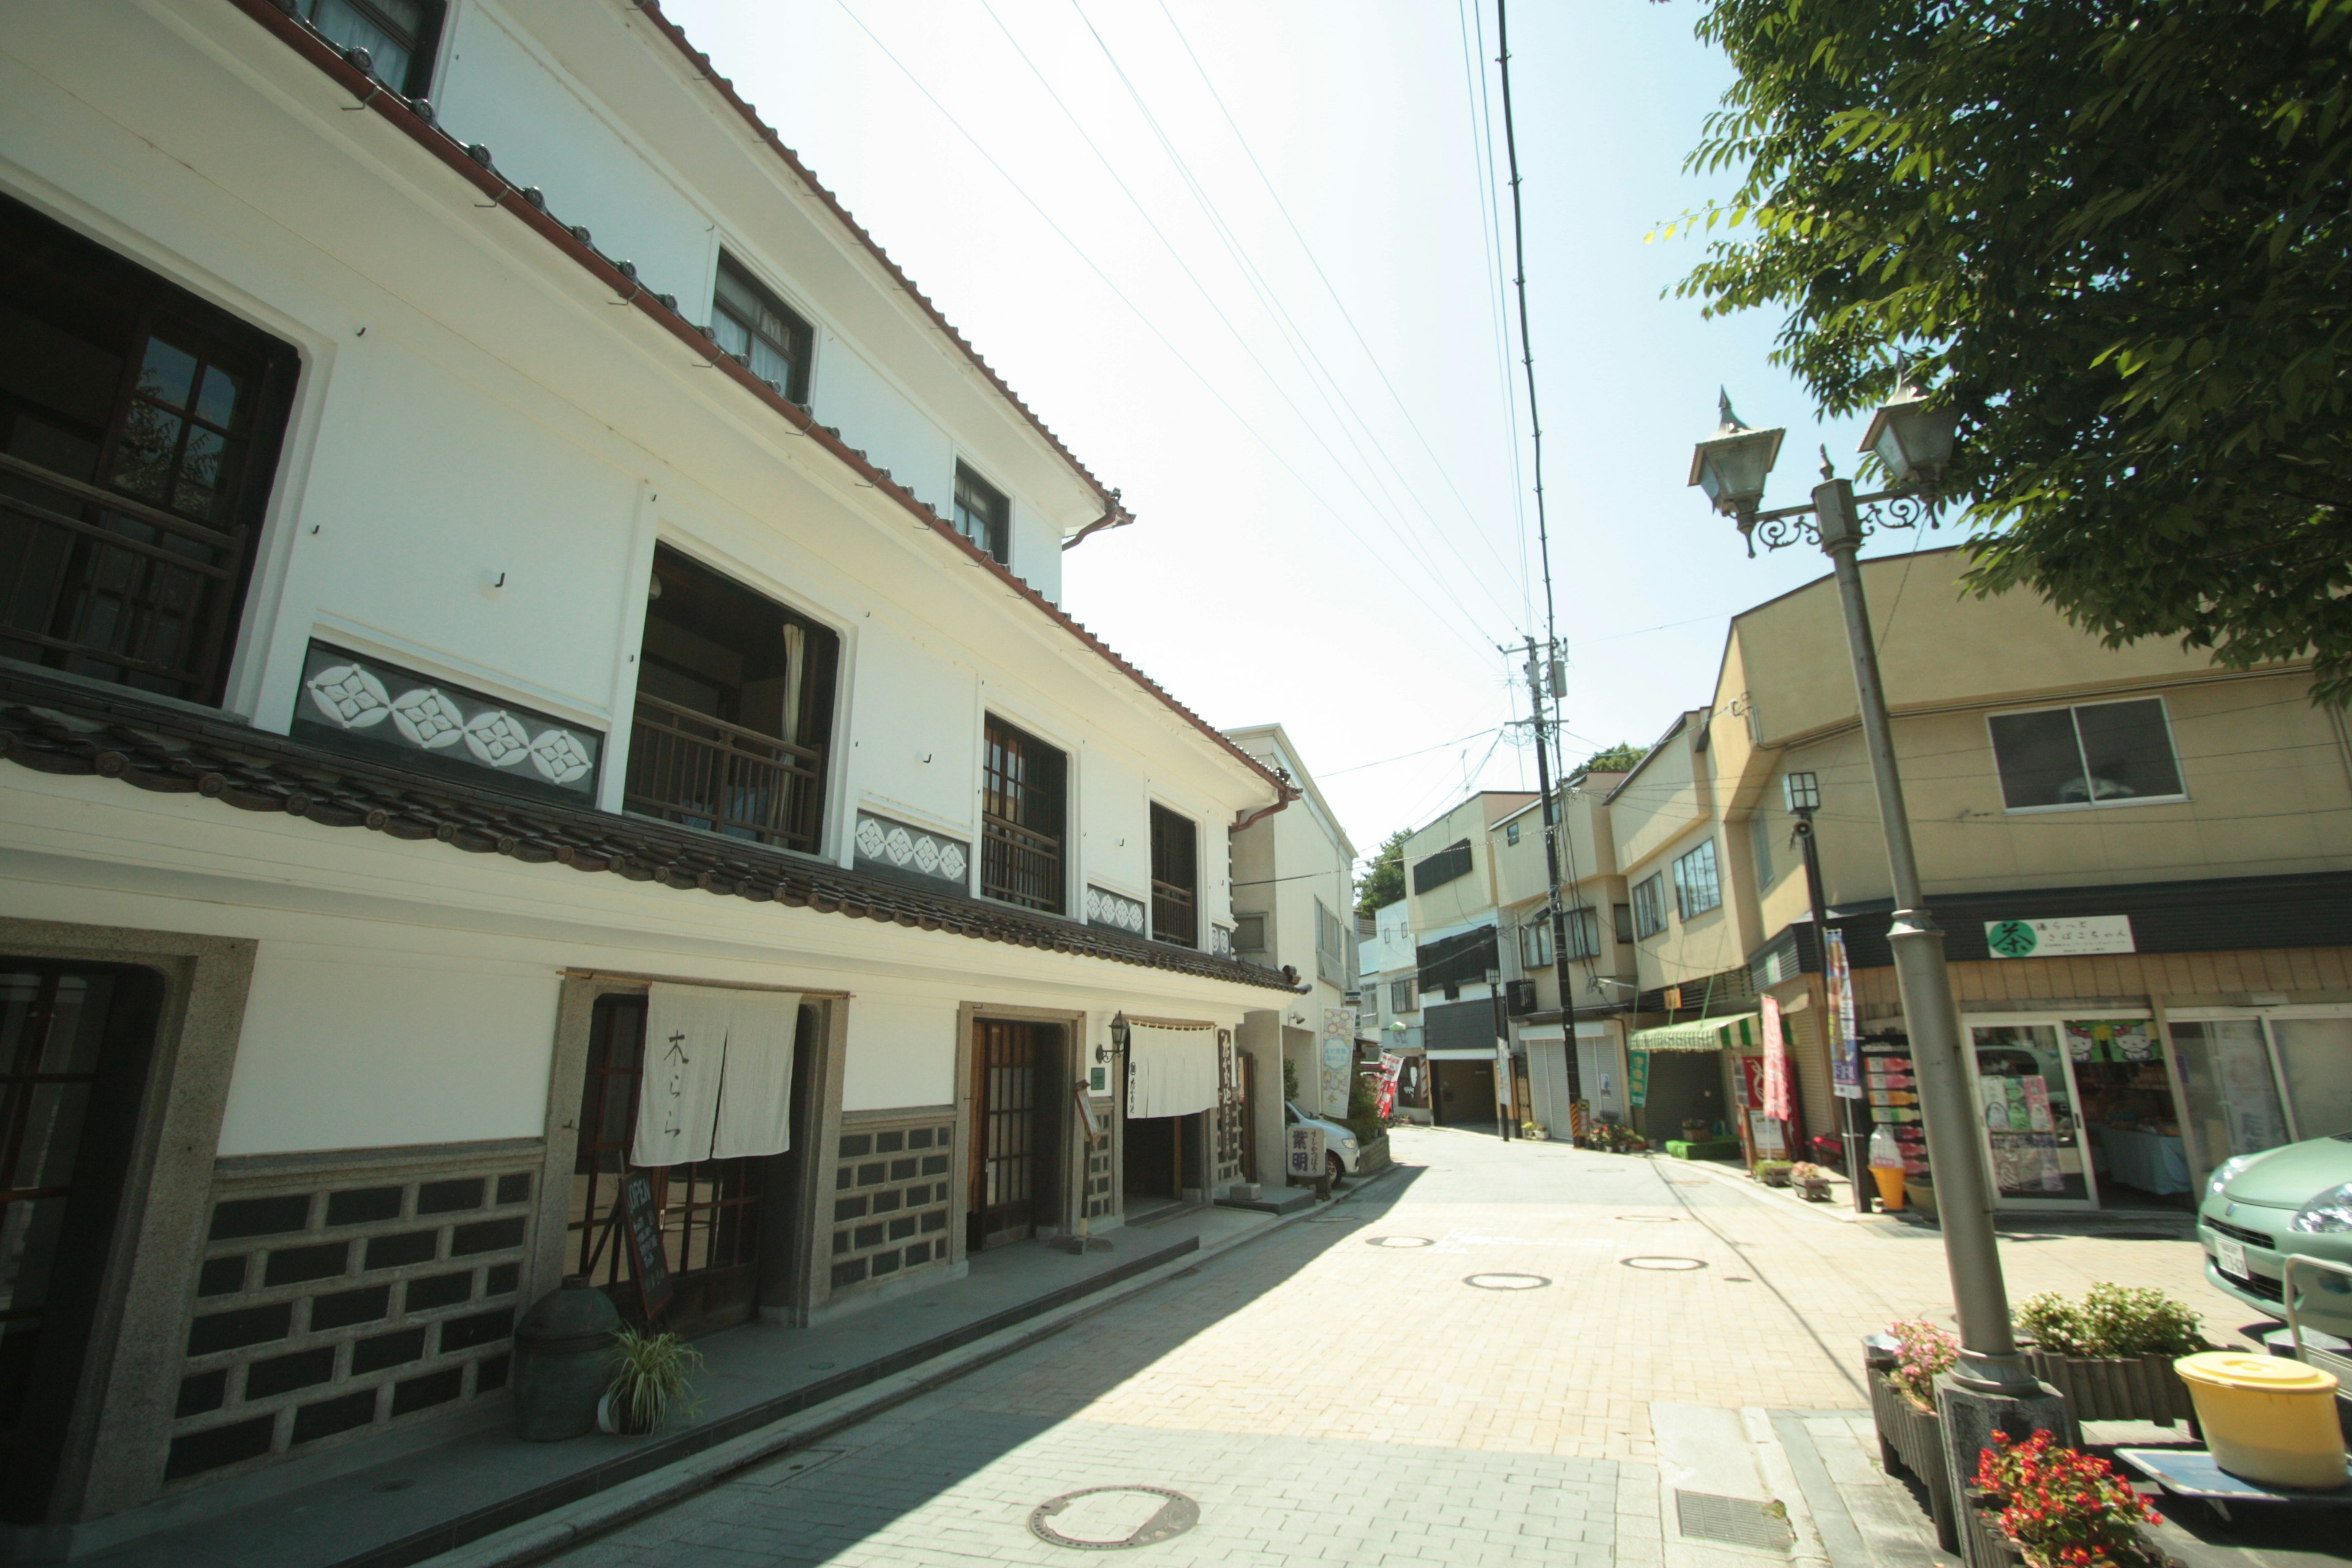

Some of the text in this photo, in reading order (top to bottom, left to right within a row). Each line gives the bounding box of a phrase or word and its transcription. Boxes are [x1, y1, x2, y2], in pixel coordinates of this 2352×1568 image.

[1992, 922, 2034, 953] 茶
[1292, 1129, 1308, 1172] 紫明
[628, 1178, 650, 1209] OPEN
